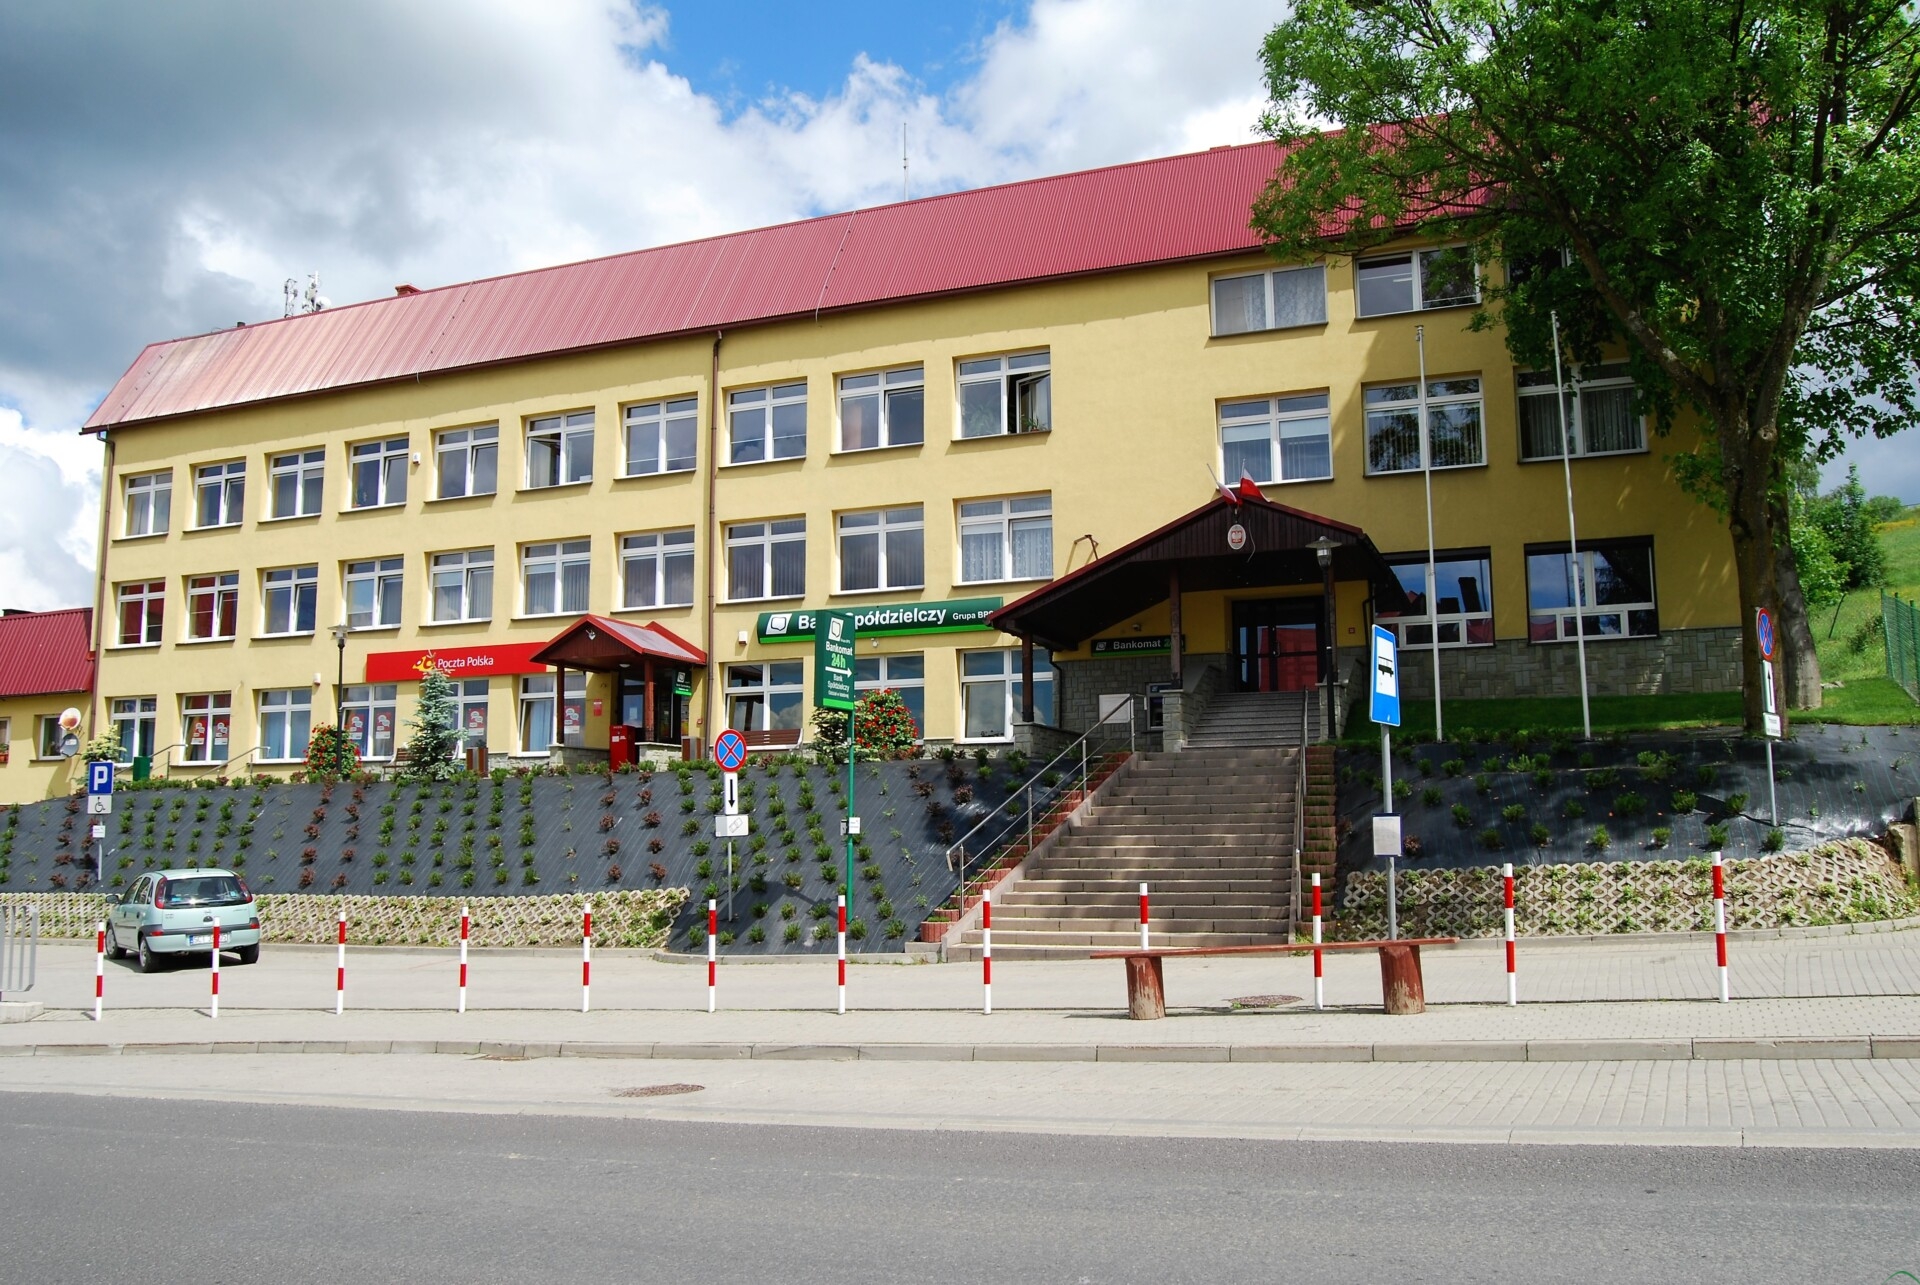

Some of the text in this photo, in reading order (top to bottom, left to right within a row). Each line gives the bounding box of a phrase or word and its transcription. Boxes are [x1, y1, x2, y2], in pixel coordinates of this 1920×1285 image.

[798, 615, 816, 630] Ba
[952, 612, 976, 621] Grupa
[826, 641, 853, 656] Bankomat
[1113, 640, 1161, 650] Bankomat
[437, 655, 494, 668] Poczta Polska
[831, 653, 846, 669] 24h
[93, 766, 108, 791] P
